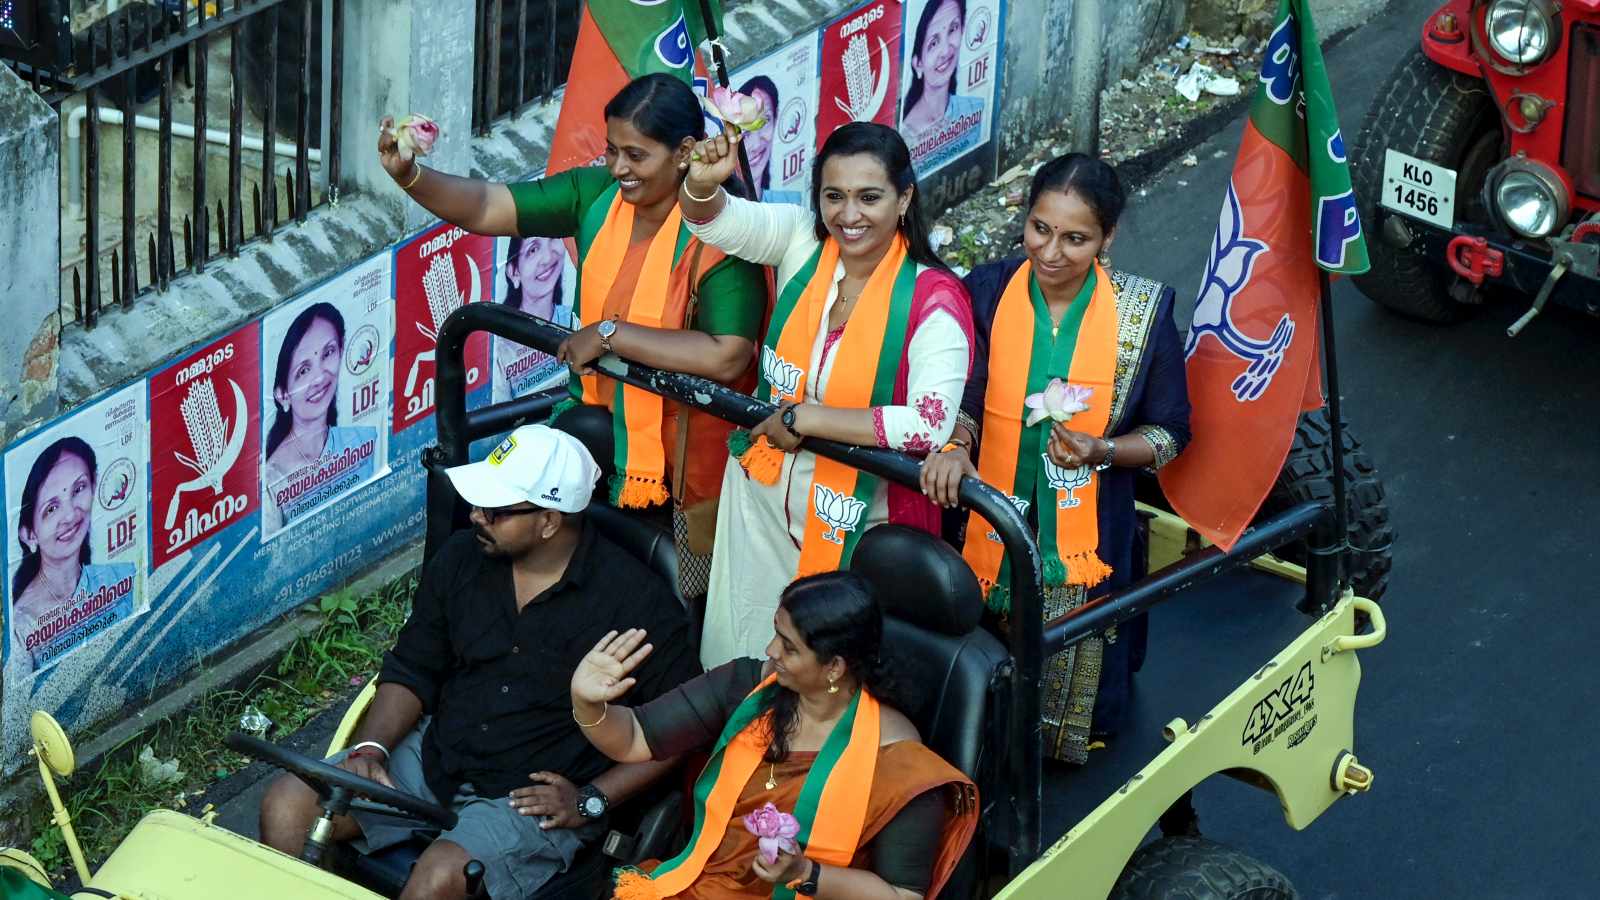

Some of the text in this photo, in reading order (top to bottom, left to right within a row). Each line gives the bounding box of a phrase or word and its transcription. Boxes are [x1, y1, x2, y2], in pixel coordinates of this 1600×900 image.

[840, 4, 884, 39] നമ്മുടെ
[967, 57, 989, 86] LDF
[782, 149, 806, 181] LDF
[1394, 185, 1438, 216] 1456
[1316, 189, 1361, 268] P
[176, 343, 234, 386] നമ്മുടെ
[352, 380, 379, 417] LDF
[121, 431, 133, 447] LDF
[107, 514, 137, 553] LDF
[1242, 660, 1314, 746] 4X4
